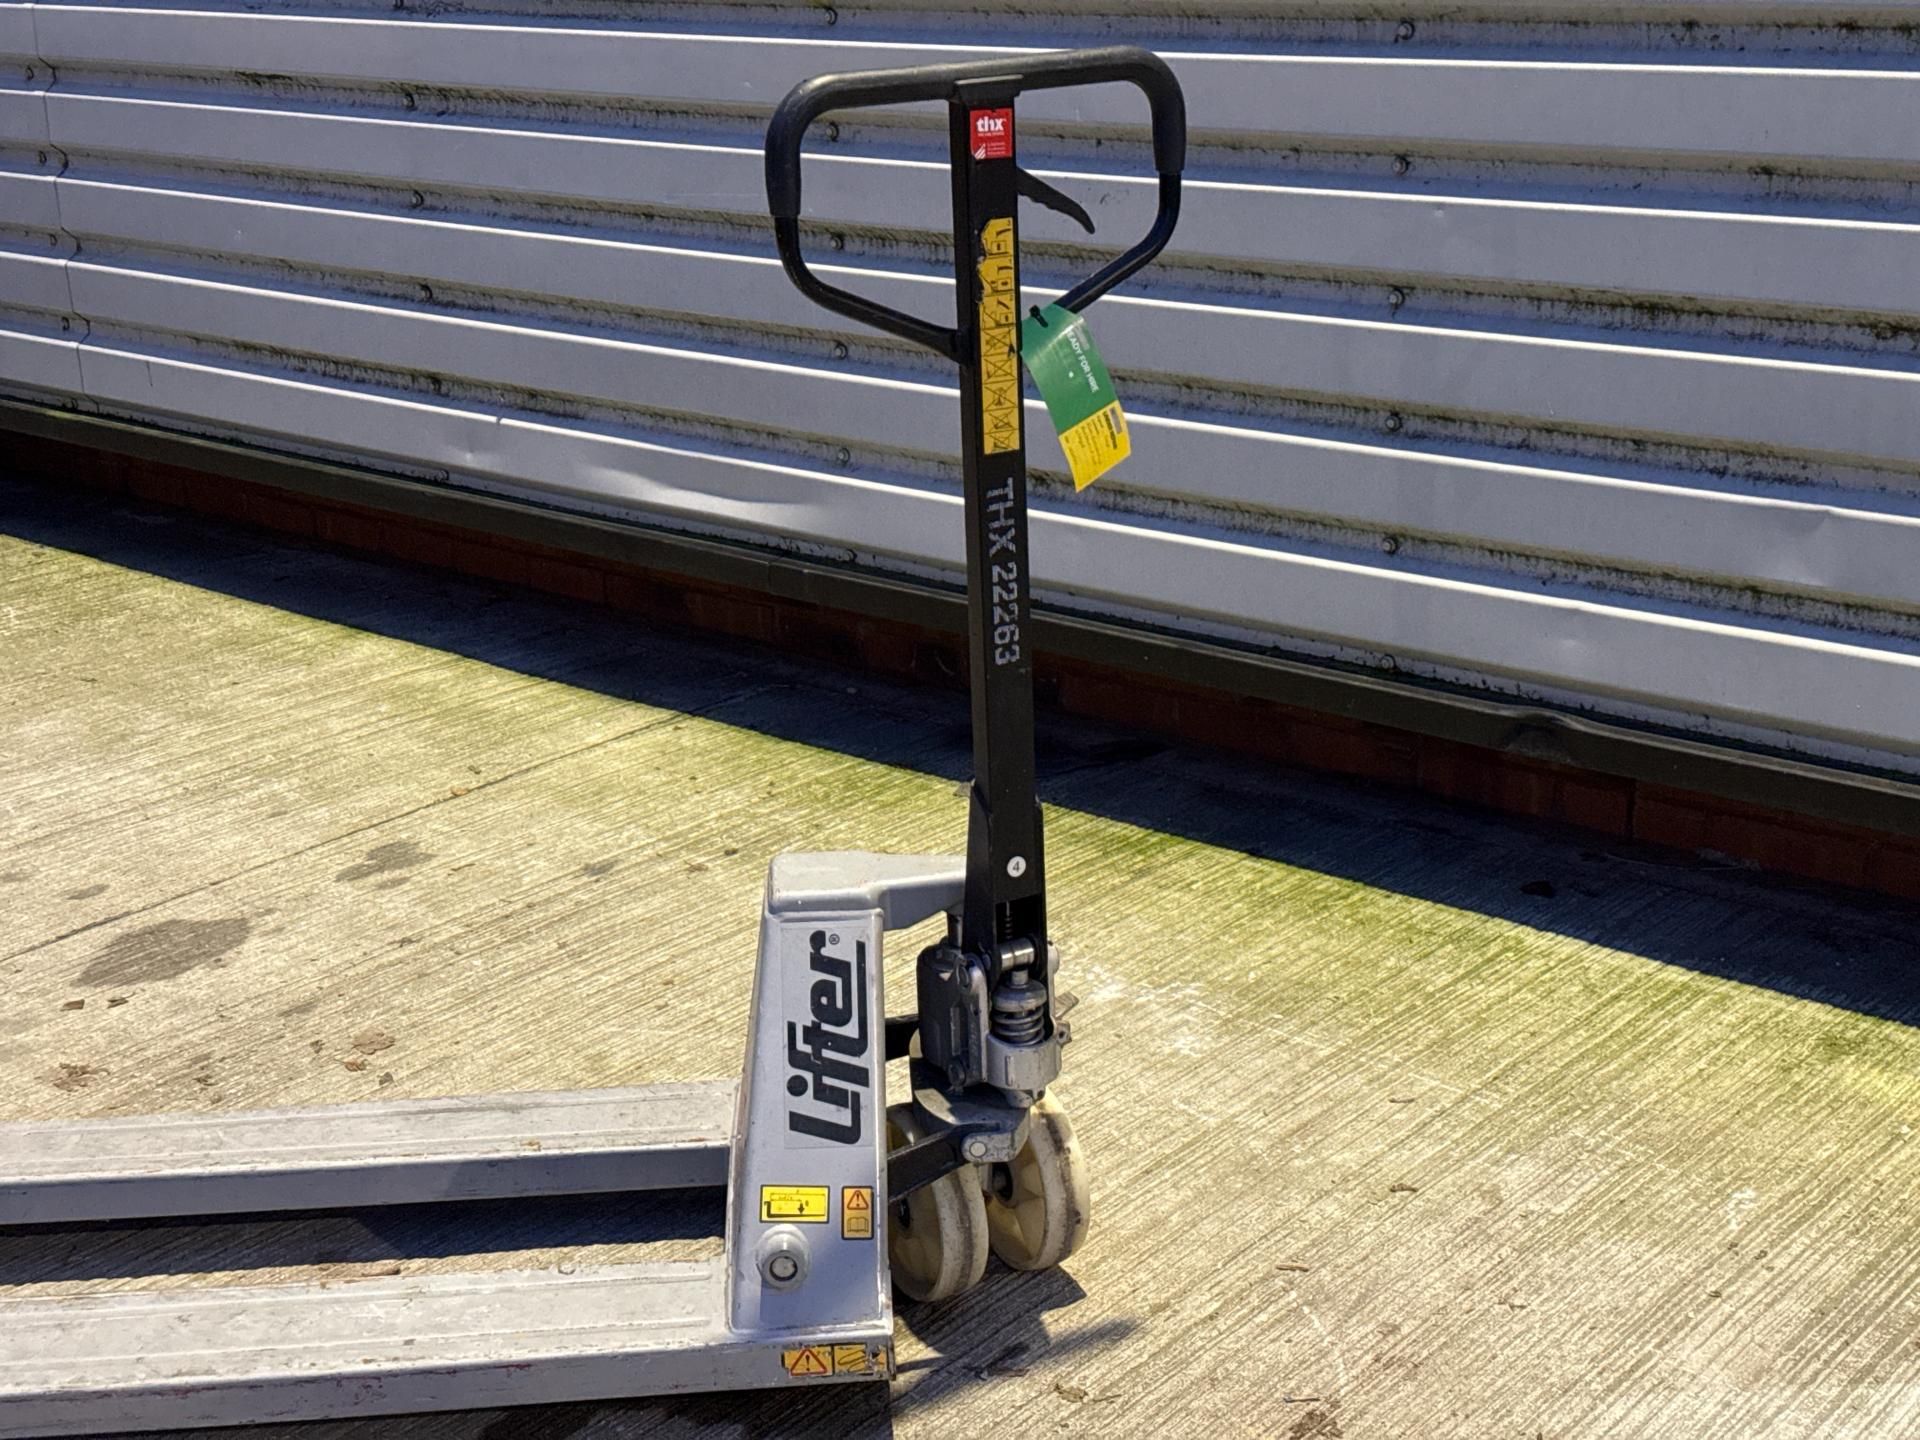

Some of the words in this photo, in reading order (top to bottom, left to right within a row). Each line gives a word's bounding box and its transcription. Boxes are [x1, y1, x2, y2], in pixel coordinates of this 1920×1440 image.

[976, 116, 1004, 132] thx
[1078, 355, 1091, 374] FOR
[987, 477, 1016, 557] THX
[992, 561, 1020, 666] 22263
